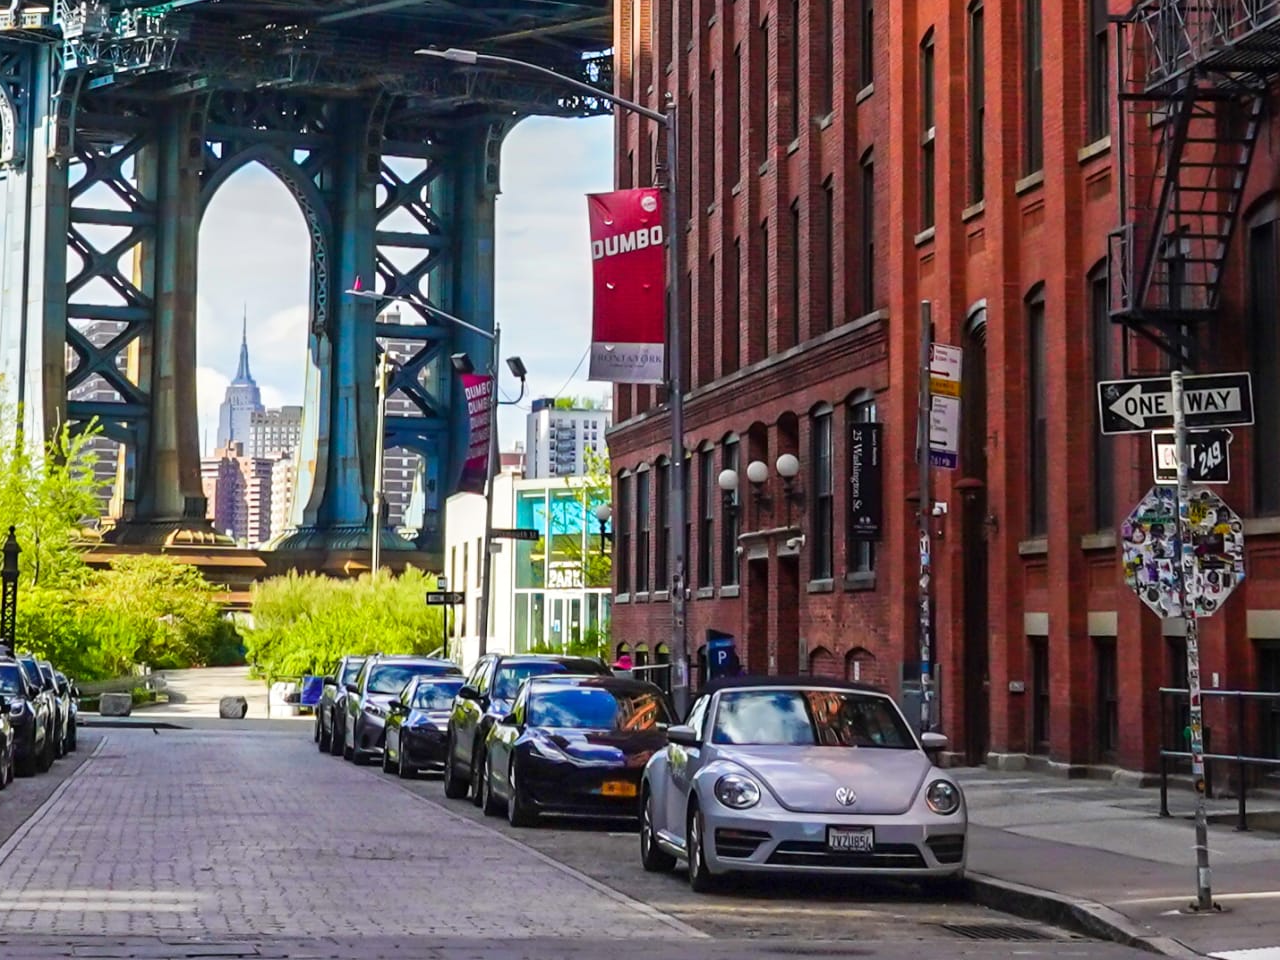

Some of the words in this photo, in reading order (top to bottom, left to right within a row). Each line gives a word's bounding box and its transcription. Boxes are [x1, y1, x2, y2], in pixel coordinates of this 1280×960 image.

[591, 225, 663, 260] DUMBO
[465, 381, 492, 400] DUMBO
[1124, 395, 1167, 416] ONE
[1187, 391, 1231, 413] WAY
[852, 429, 862, 440] 25
[851, 444, 862, 498] Washington
[1199, 441, 1224, 476] 249
[718, 650, 727, 665] P
